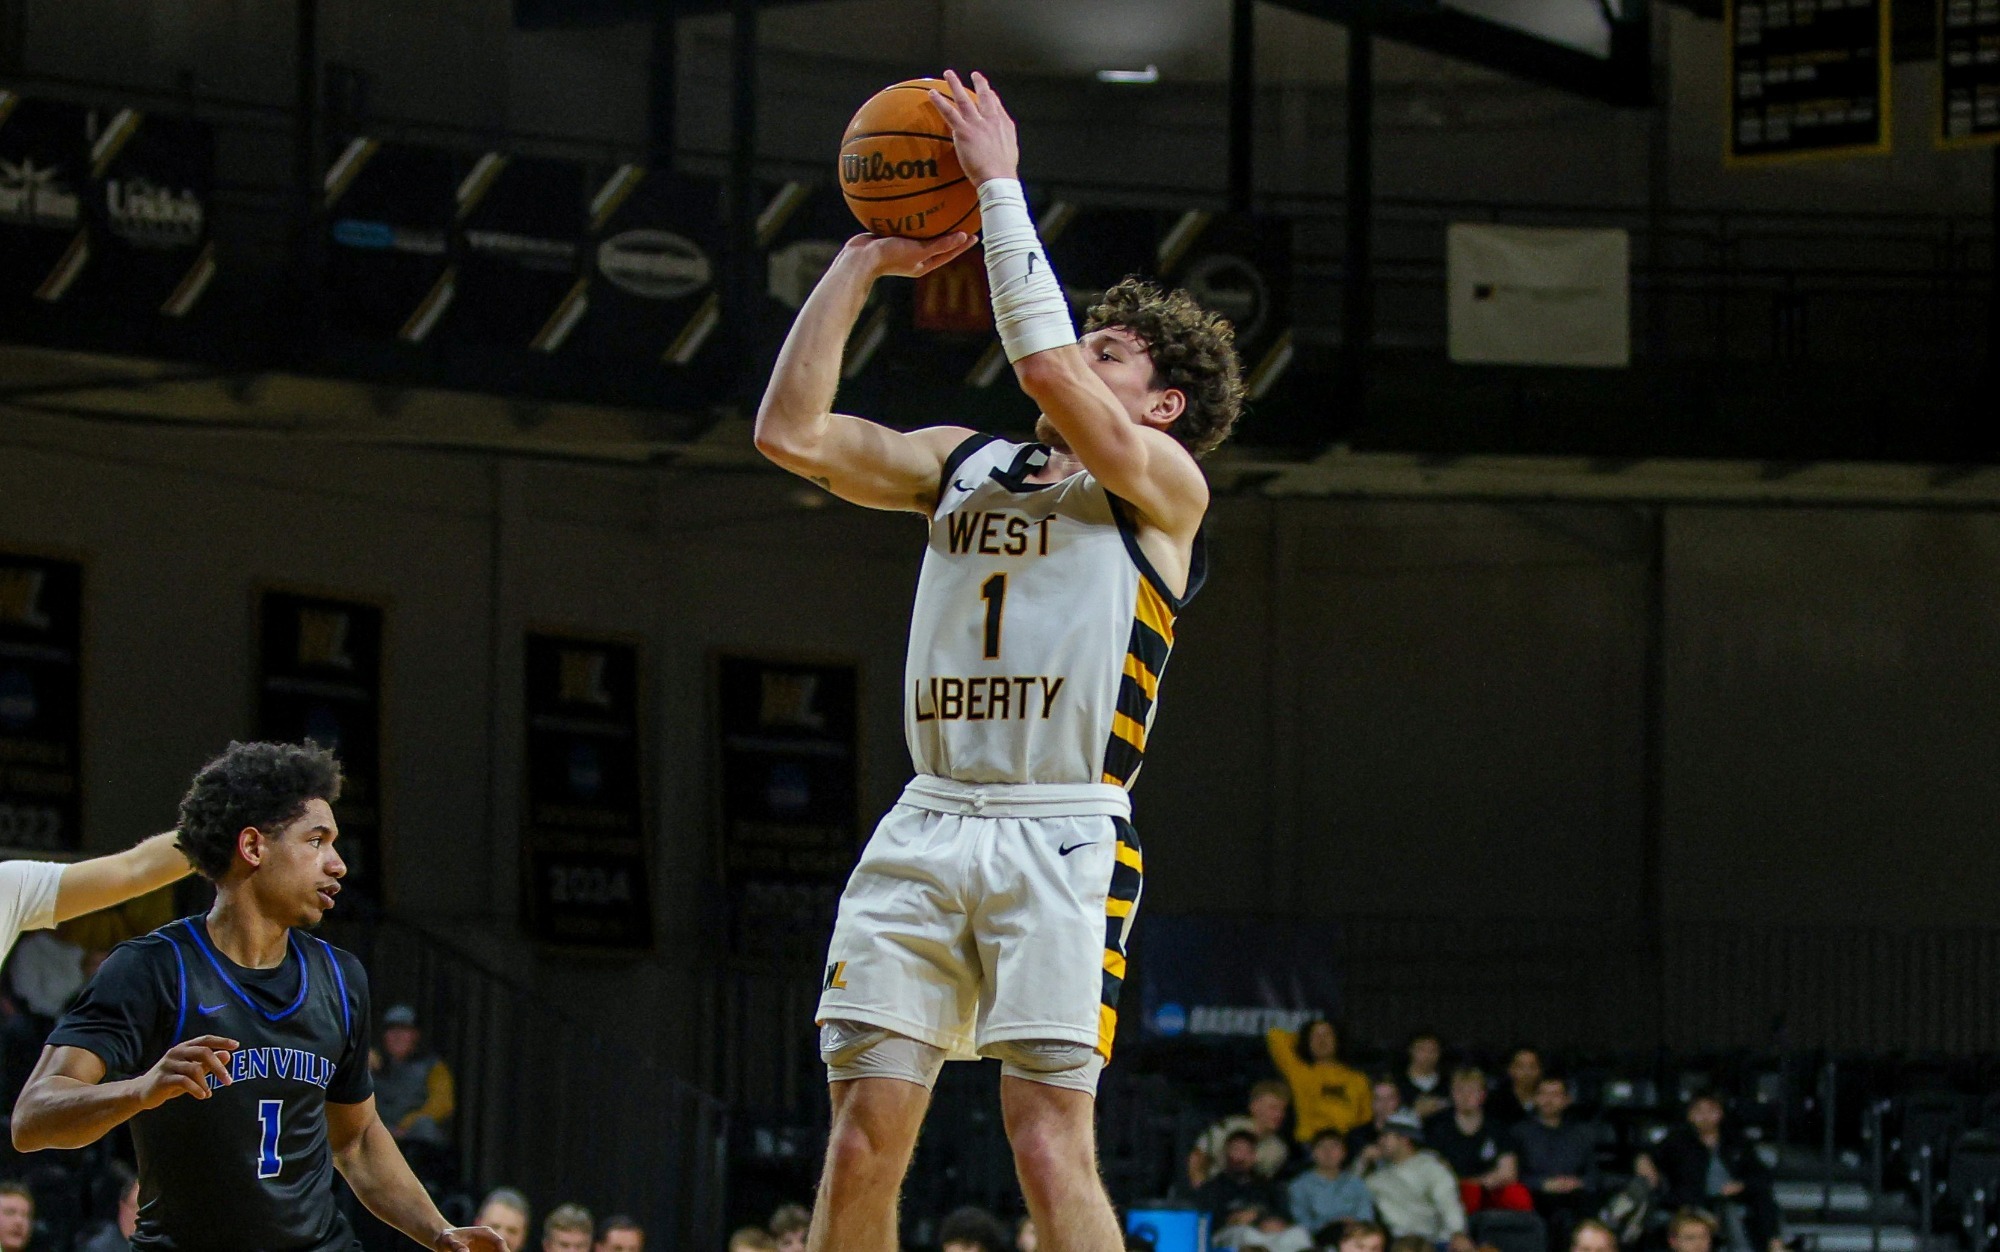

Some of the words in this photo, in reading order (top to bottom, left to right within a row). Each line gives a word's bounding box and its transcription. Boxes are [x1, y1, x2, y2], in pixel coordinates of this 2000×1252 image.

[842, 151, 938, 184] Wilson
[948, 511, 1057, 556] WEST
[980, 571, 1008, 660] 1
[915, 676, 1065, 722] LIBERTY
[205, 1047, 337, 1090] ENVILL
[258, 1099, 284, 1179] 1
